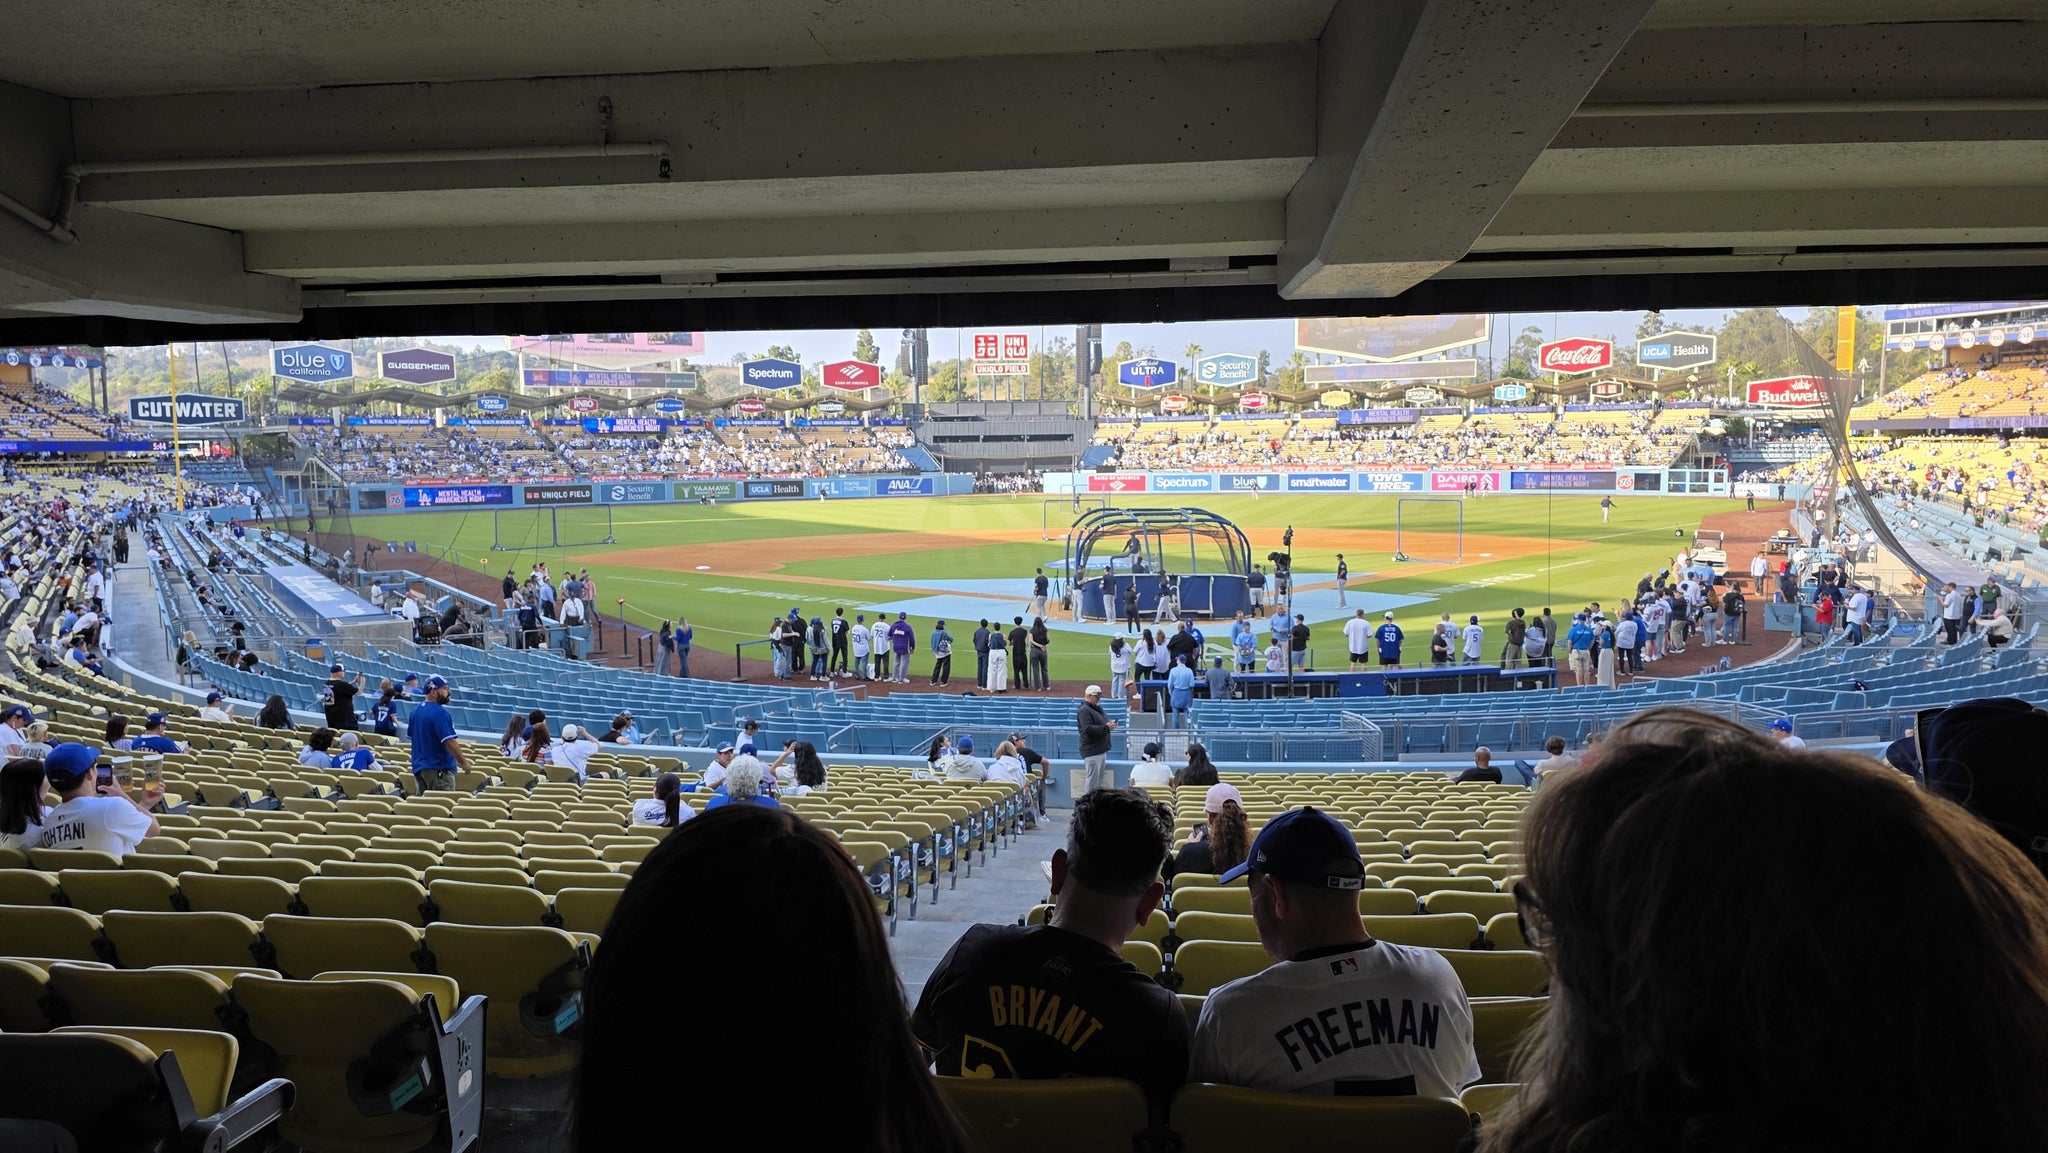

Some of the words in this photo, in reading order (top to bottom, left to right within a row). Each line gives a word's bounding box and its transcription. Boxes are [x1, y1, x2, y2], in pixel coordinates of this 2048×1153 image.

[977, 337, 996, 346] ユニ
[1006, 337, 1024, 346] UNI
[977, 347, 996, 357] クロ
[1006, 347, 1026, 357] QLO
[1545, 345, 1604, 366] Coca-Cola
[1643, 349, 1667, 357] UCLA
[1673, 345, 1708, 356] Health
[9, 355, 17, 363] 53
[281, 351, 325, 367] blue
[388, 362, 450, 371] GUGGENHEIM
[1005, 365, 1026, 373] FIELD
[1219, 361, 1252, 370] Security
[289, 367, 331, 376] california
[749, 368, 793, 380] Spectrum
[1131, 366, 1165, 376] ULTRA
[1219, 370, 1247, 379] Benefit
[1499, 387, 1522, 399] TEL
[573, 399, 594, 408] JINRO
[138, 400, 237, 418] CUTWATER
[598, 417, 609, 433] LA
[153, 442, 167, 451] 5:44
[1233, 477, 1256, 486] blue
[1367, 473, 1403, 482] TOYO
[888, 480, 910, 489] ANA
[1156, 477, 1203, 489] Spectrum
[1290, 478, 1347, 487] smartwater
[1373, 482, 1411, 490] TIRES
[627, 485, 654, 494] Security
[773, 484, 800, 493] Health
[812, 482, 839, 494] TEL
[418, 489, 431, 506] LA
[541, 491, 568, 500] UNIQLO
[570, 489, 590, 498] FIELD
[627, 492, 651, 500] Benefit
[390, 496, 401, 505] 76
[875, 630, 883, 638] 72
[1384, 632, 1396, 642] 50
[1473, 633, 1478, 642] 5
[377, 711, 388, 722] 17
[340, 759, 355, 769] 17
[43, 822, 86, 847] OHTANI
[988, 984, 1105, 1053] BRYANT
[1274, 997, 1440, 1073] FREEMAN
